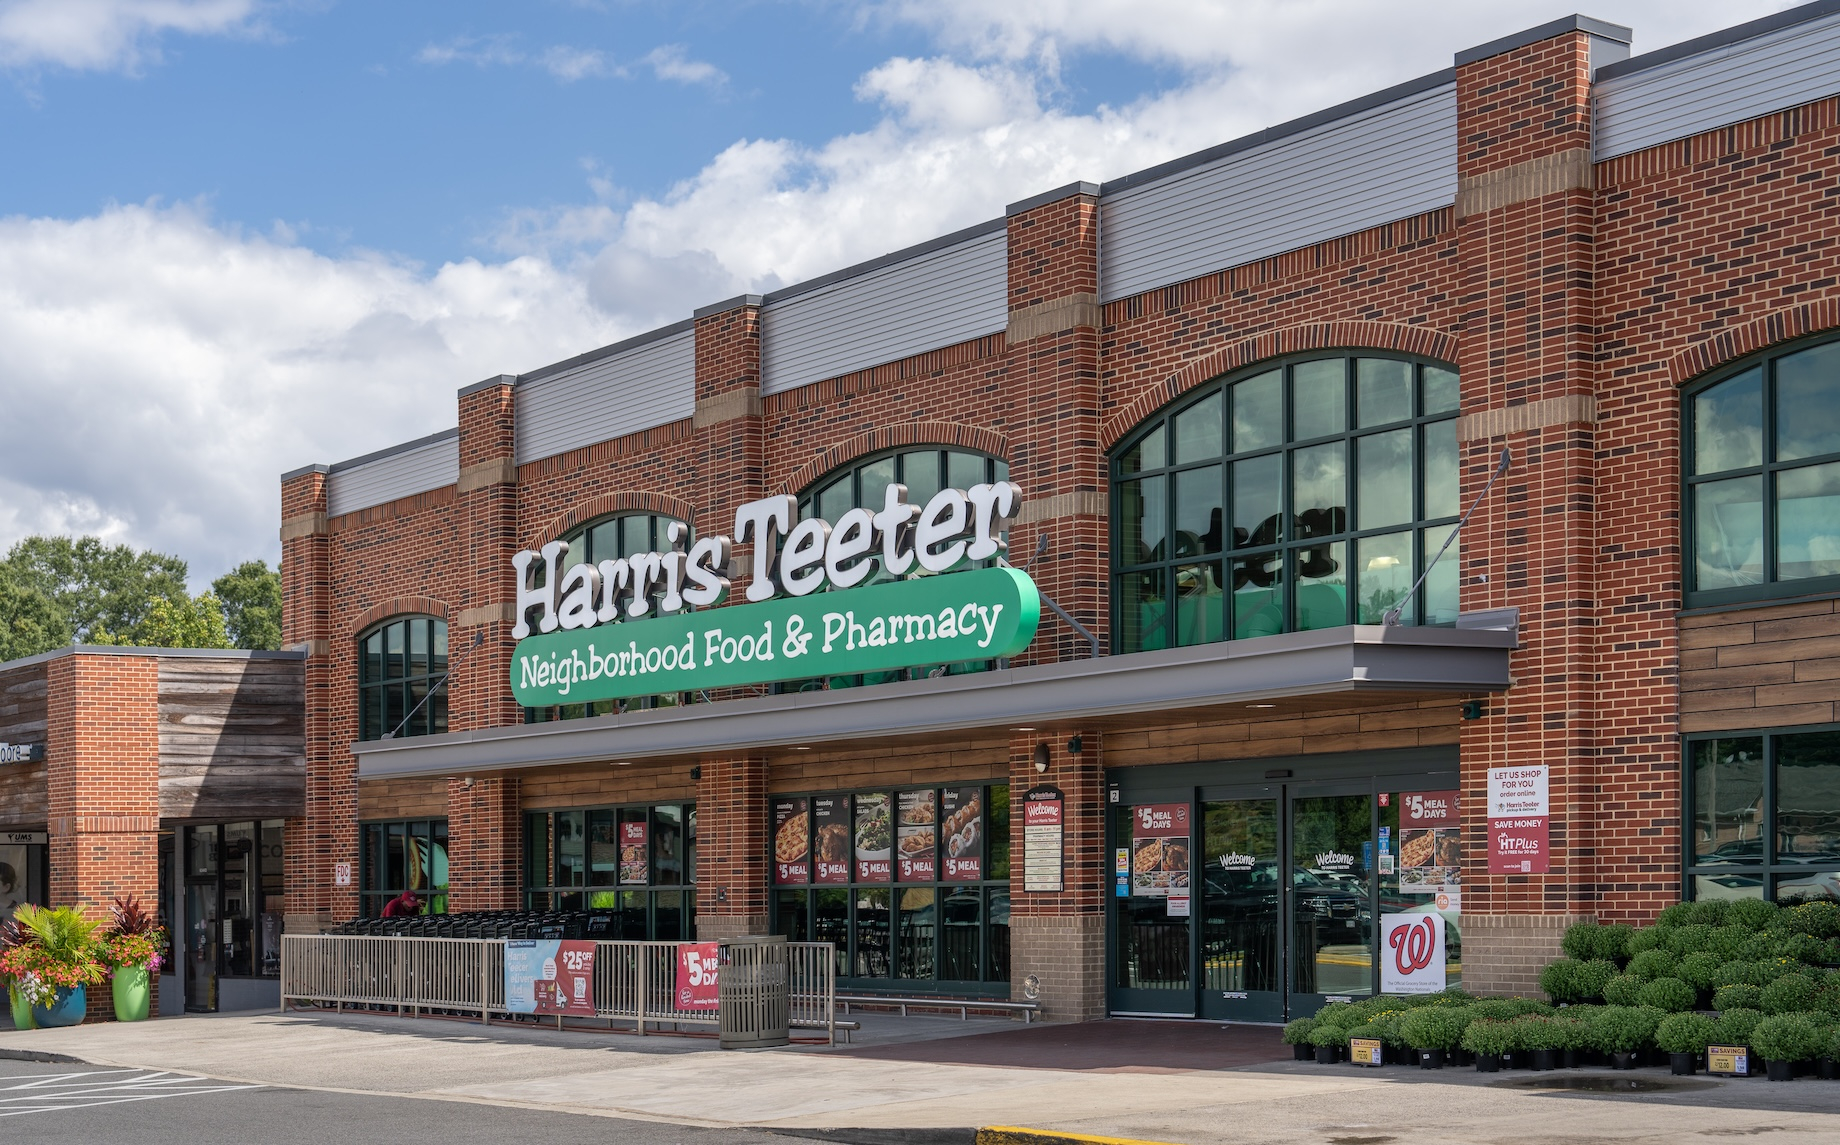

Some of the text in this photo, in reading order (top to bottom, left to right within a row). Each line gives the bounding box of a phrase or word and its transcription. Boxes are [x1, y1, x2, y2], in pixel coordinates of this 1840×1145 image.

[511, 481, 1022, 640] Harris Teeter
[519, 602, 1004, 696] Neighborhood Food & Pharmacy
[1494, 772, 1508, 780] LET
[1520, 770, 1542, 778] SHOP
[1112, 792, 1117, 800] 2
[1028, 802, 1058, 817] Welcome
[1406, 796, 1424, 819] $5
[1424, 799, 1447, 808] MEAL
[1424, 809, 1447, 818] DAYS
[1138, 808, 1153, 829] $5
[1153, 820, 1172, 828] DAYS
[1514, 820, 1542, 828] MONEY
[1219, 851, 1256, 866] Welcome
[1315, 850, 1354, 866] Welcome
[337, 866, 349, 877] FDC
[779, 864, 807, 879] $5 MEAL
[818, 863, 847, 878] $5 MEAL
[860, 862, 890, 877] $5 MEAL
[902, 861, 933, 876] $5 MEAL
[946, 859, 979, 875] $5 MEAL
[1389, 916, 1436, 975] W
[508, 951, 527, 960] Harris
[563, 950, 582, 970] $25
[582, 951, 593, 961] OFF
[682, 951, 703, 986] $5
